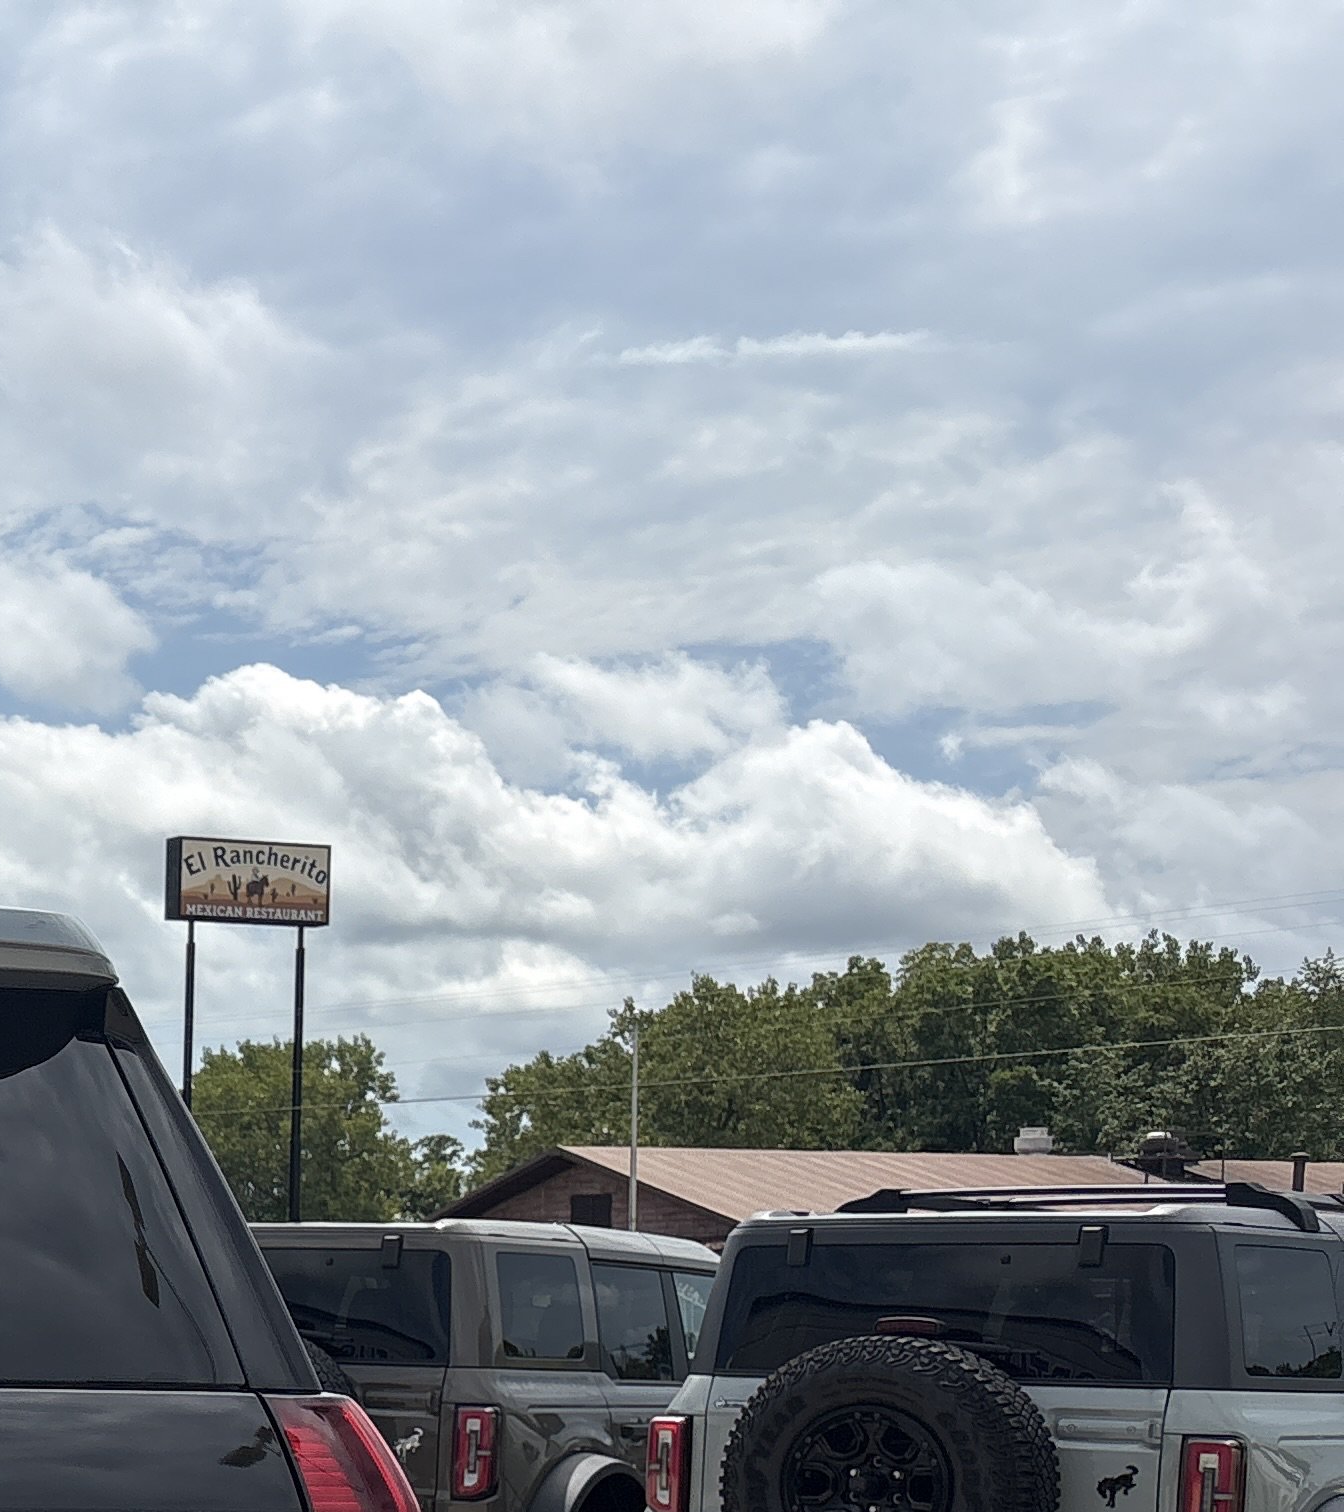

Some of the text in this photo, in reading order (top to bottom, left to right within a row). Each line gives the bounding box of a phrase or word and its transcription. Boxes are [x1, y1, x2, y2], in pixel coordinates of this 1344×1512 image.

[183, 846, 327, 885] El Rancherito
[185, 903, 324, 922] MEXICAN RESTAURANT
